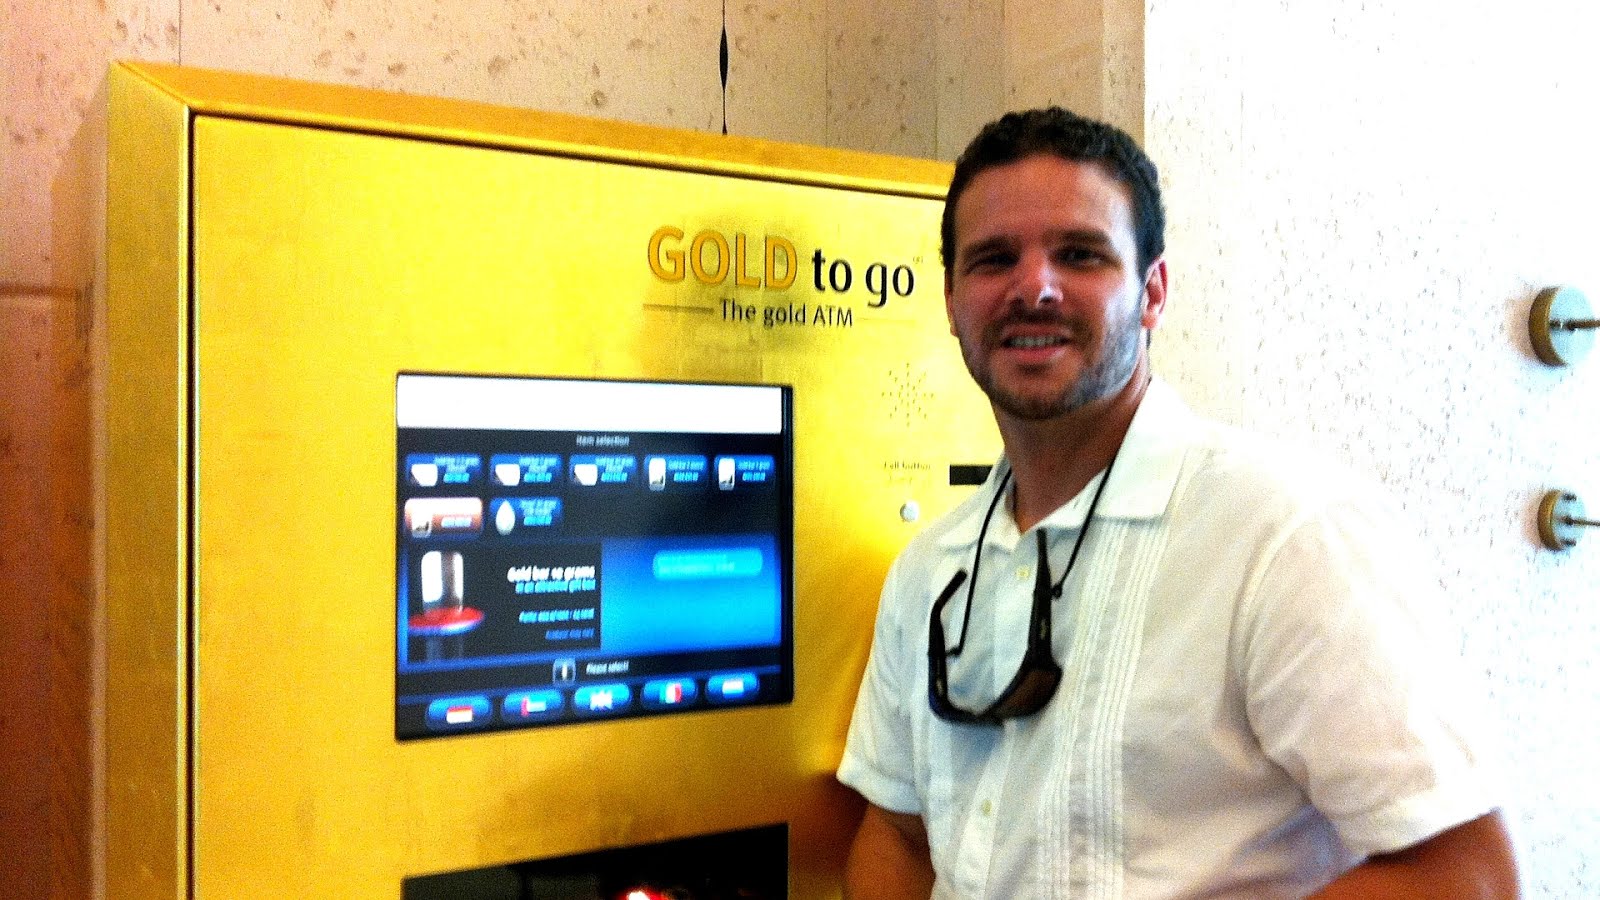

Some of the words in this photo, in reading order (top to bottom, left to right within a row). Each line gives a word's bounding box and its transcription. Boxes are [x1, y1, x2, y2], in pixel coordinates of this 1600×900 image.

[647, 225, 798, 291] GOLD
[812, 248, 853, 294] to
[865, 261, 915, 309] go
[719, 298, 756, 322] The
[763, 302, 806, 328] gold
[812, 304, 853, 328] ATM
